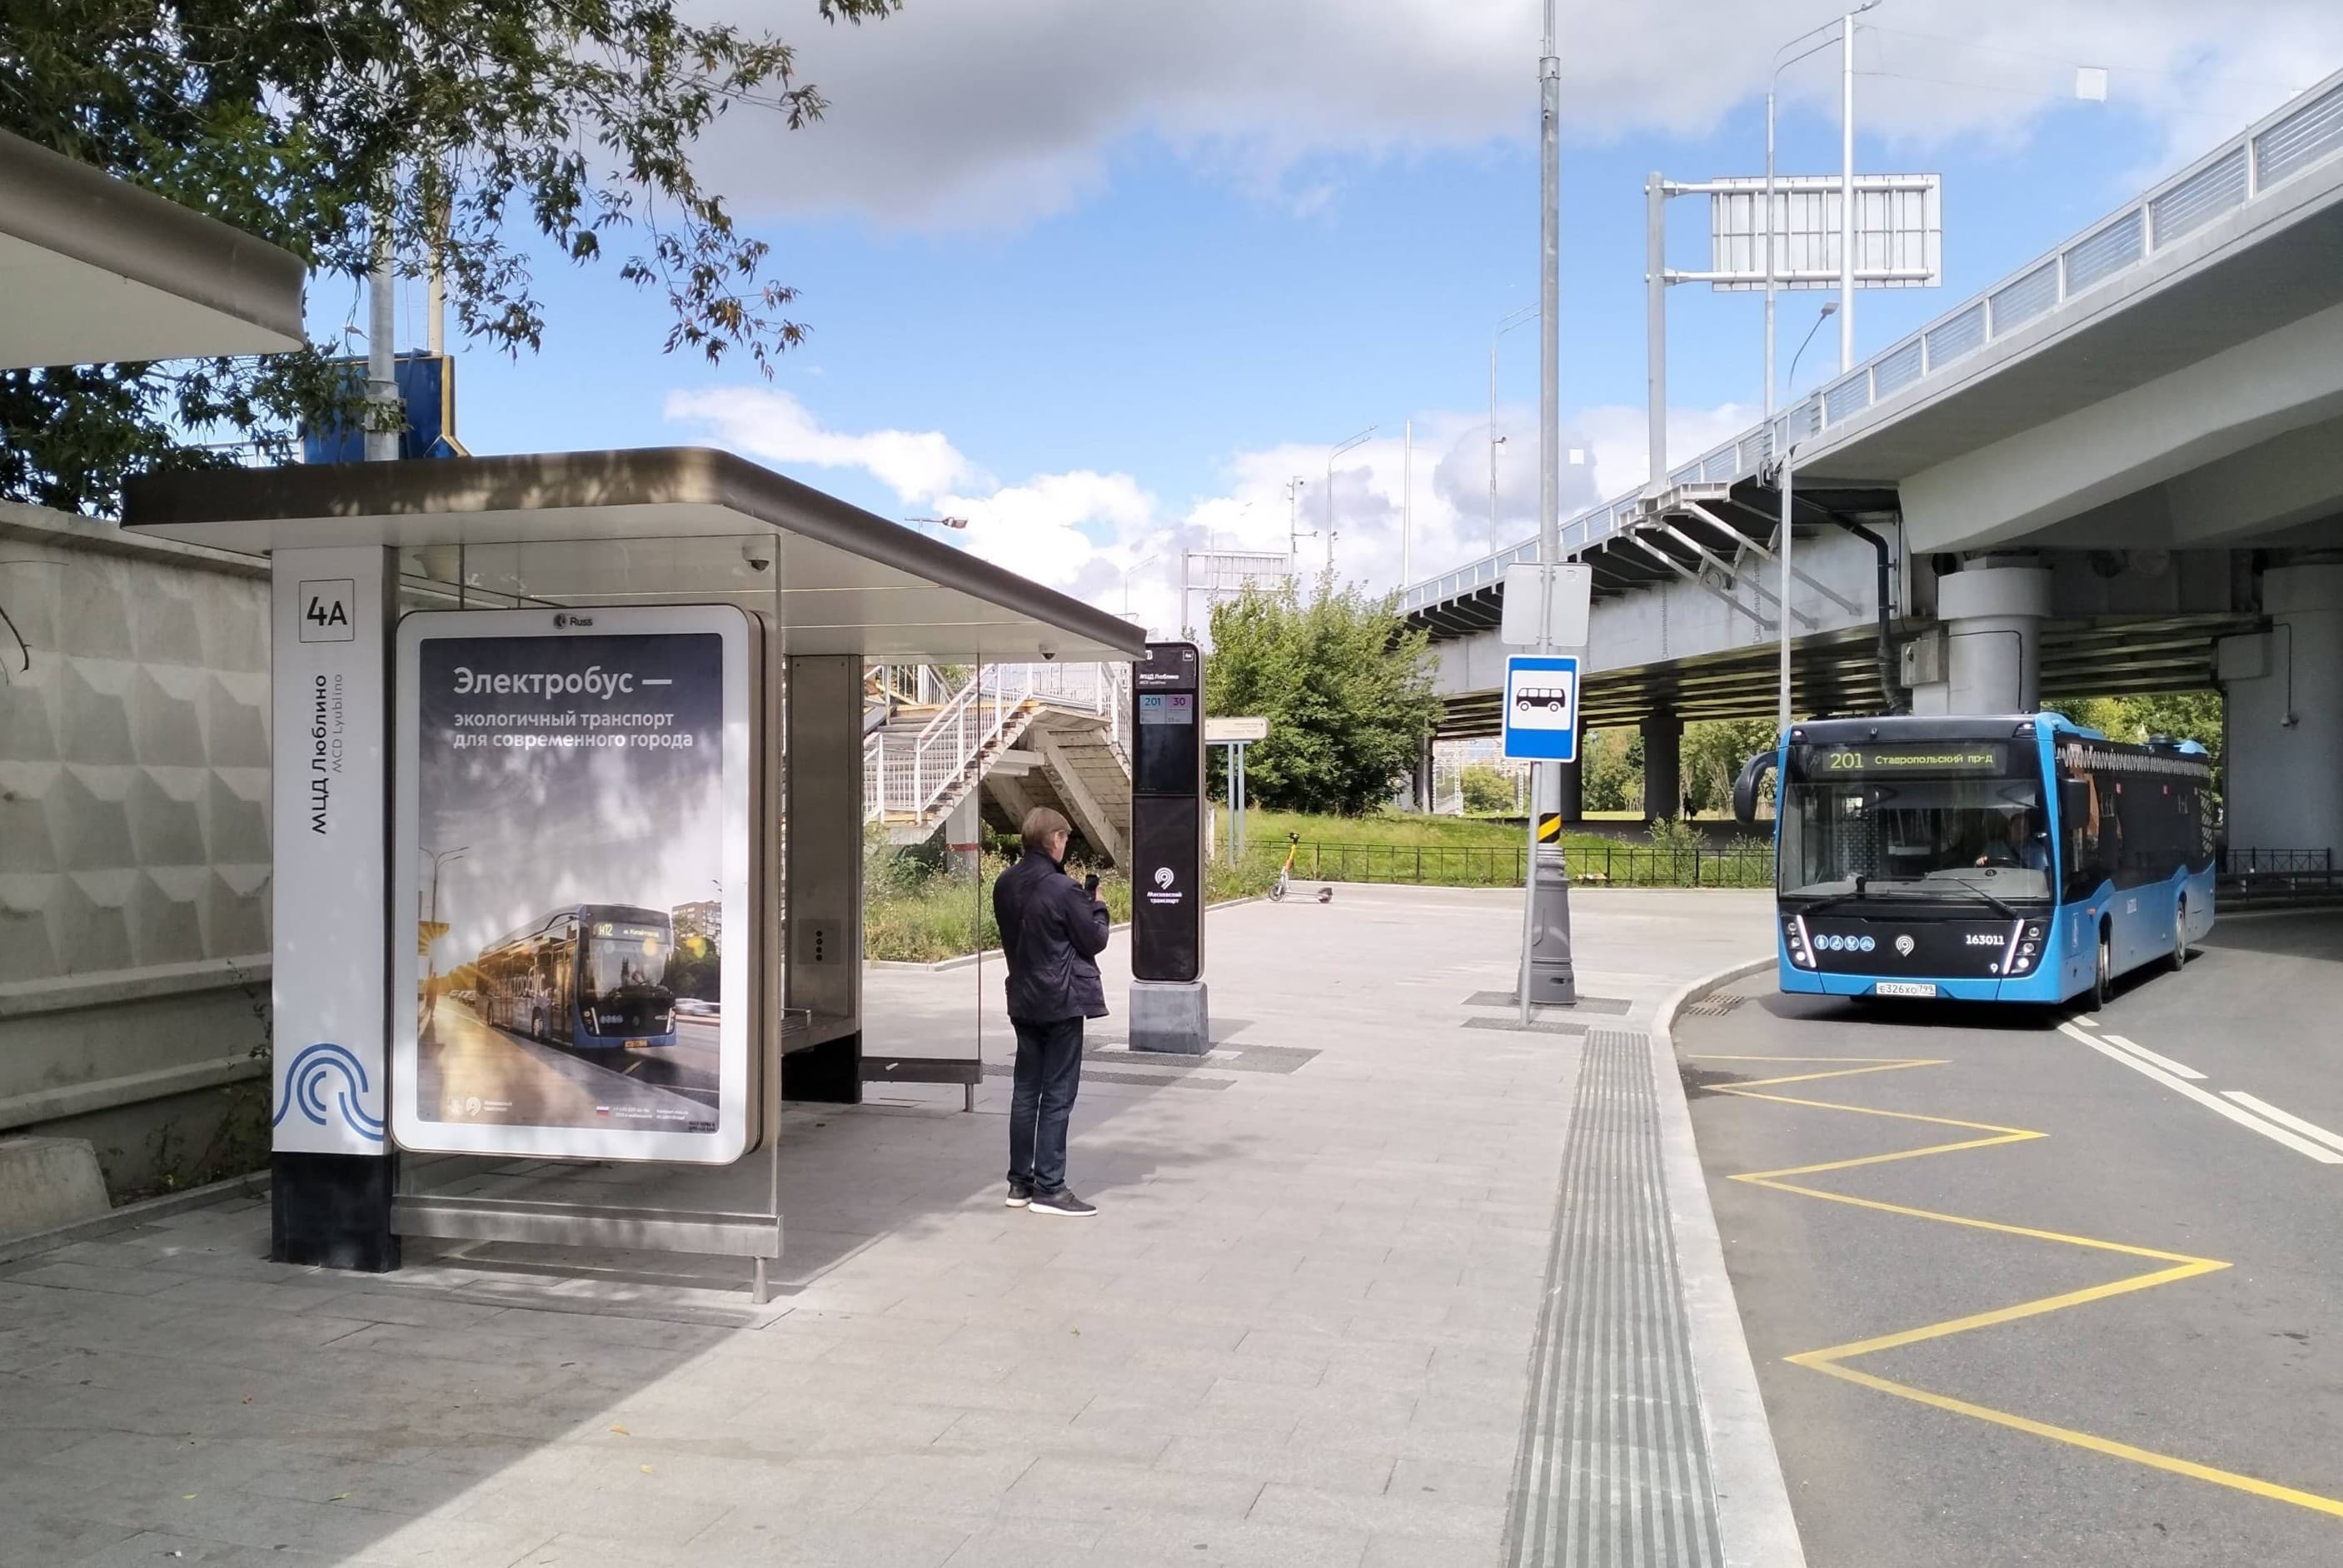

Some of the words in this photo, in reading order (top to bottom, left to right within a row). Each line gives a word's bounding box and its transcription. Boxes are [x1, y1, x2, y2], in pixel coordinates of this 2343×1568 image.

[307, 596, 348, 626] 4А
[570, 616, 593, 626] Russ
[453, 665, 634, 700] Электробус
[332, 674, 345, 734] Lyublino
[1145, 698, 1160, 707] 201
[1173, 698, 1186, 706] 30
[312, 674, 327, 773] Люблино
[454, 710, 576, 727] экологичный
[581, 713, 675, 730] транспорт
[453, 734, 487, 749] для
[493, 734, 626, 751] современного
[631, 734, 693, 750] города
[332, 738, 342, 774] MCD
[1830, 753, 1863, 769] 201
[1874, 754, 1964, 766] Ставропольский
[1968, 754, 1993, 764] пр-д
[312, 778, 329, 834] МЦД
[1965, 934, 2005, 946] 163011
